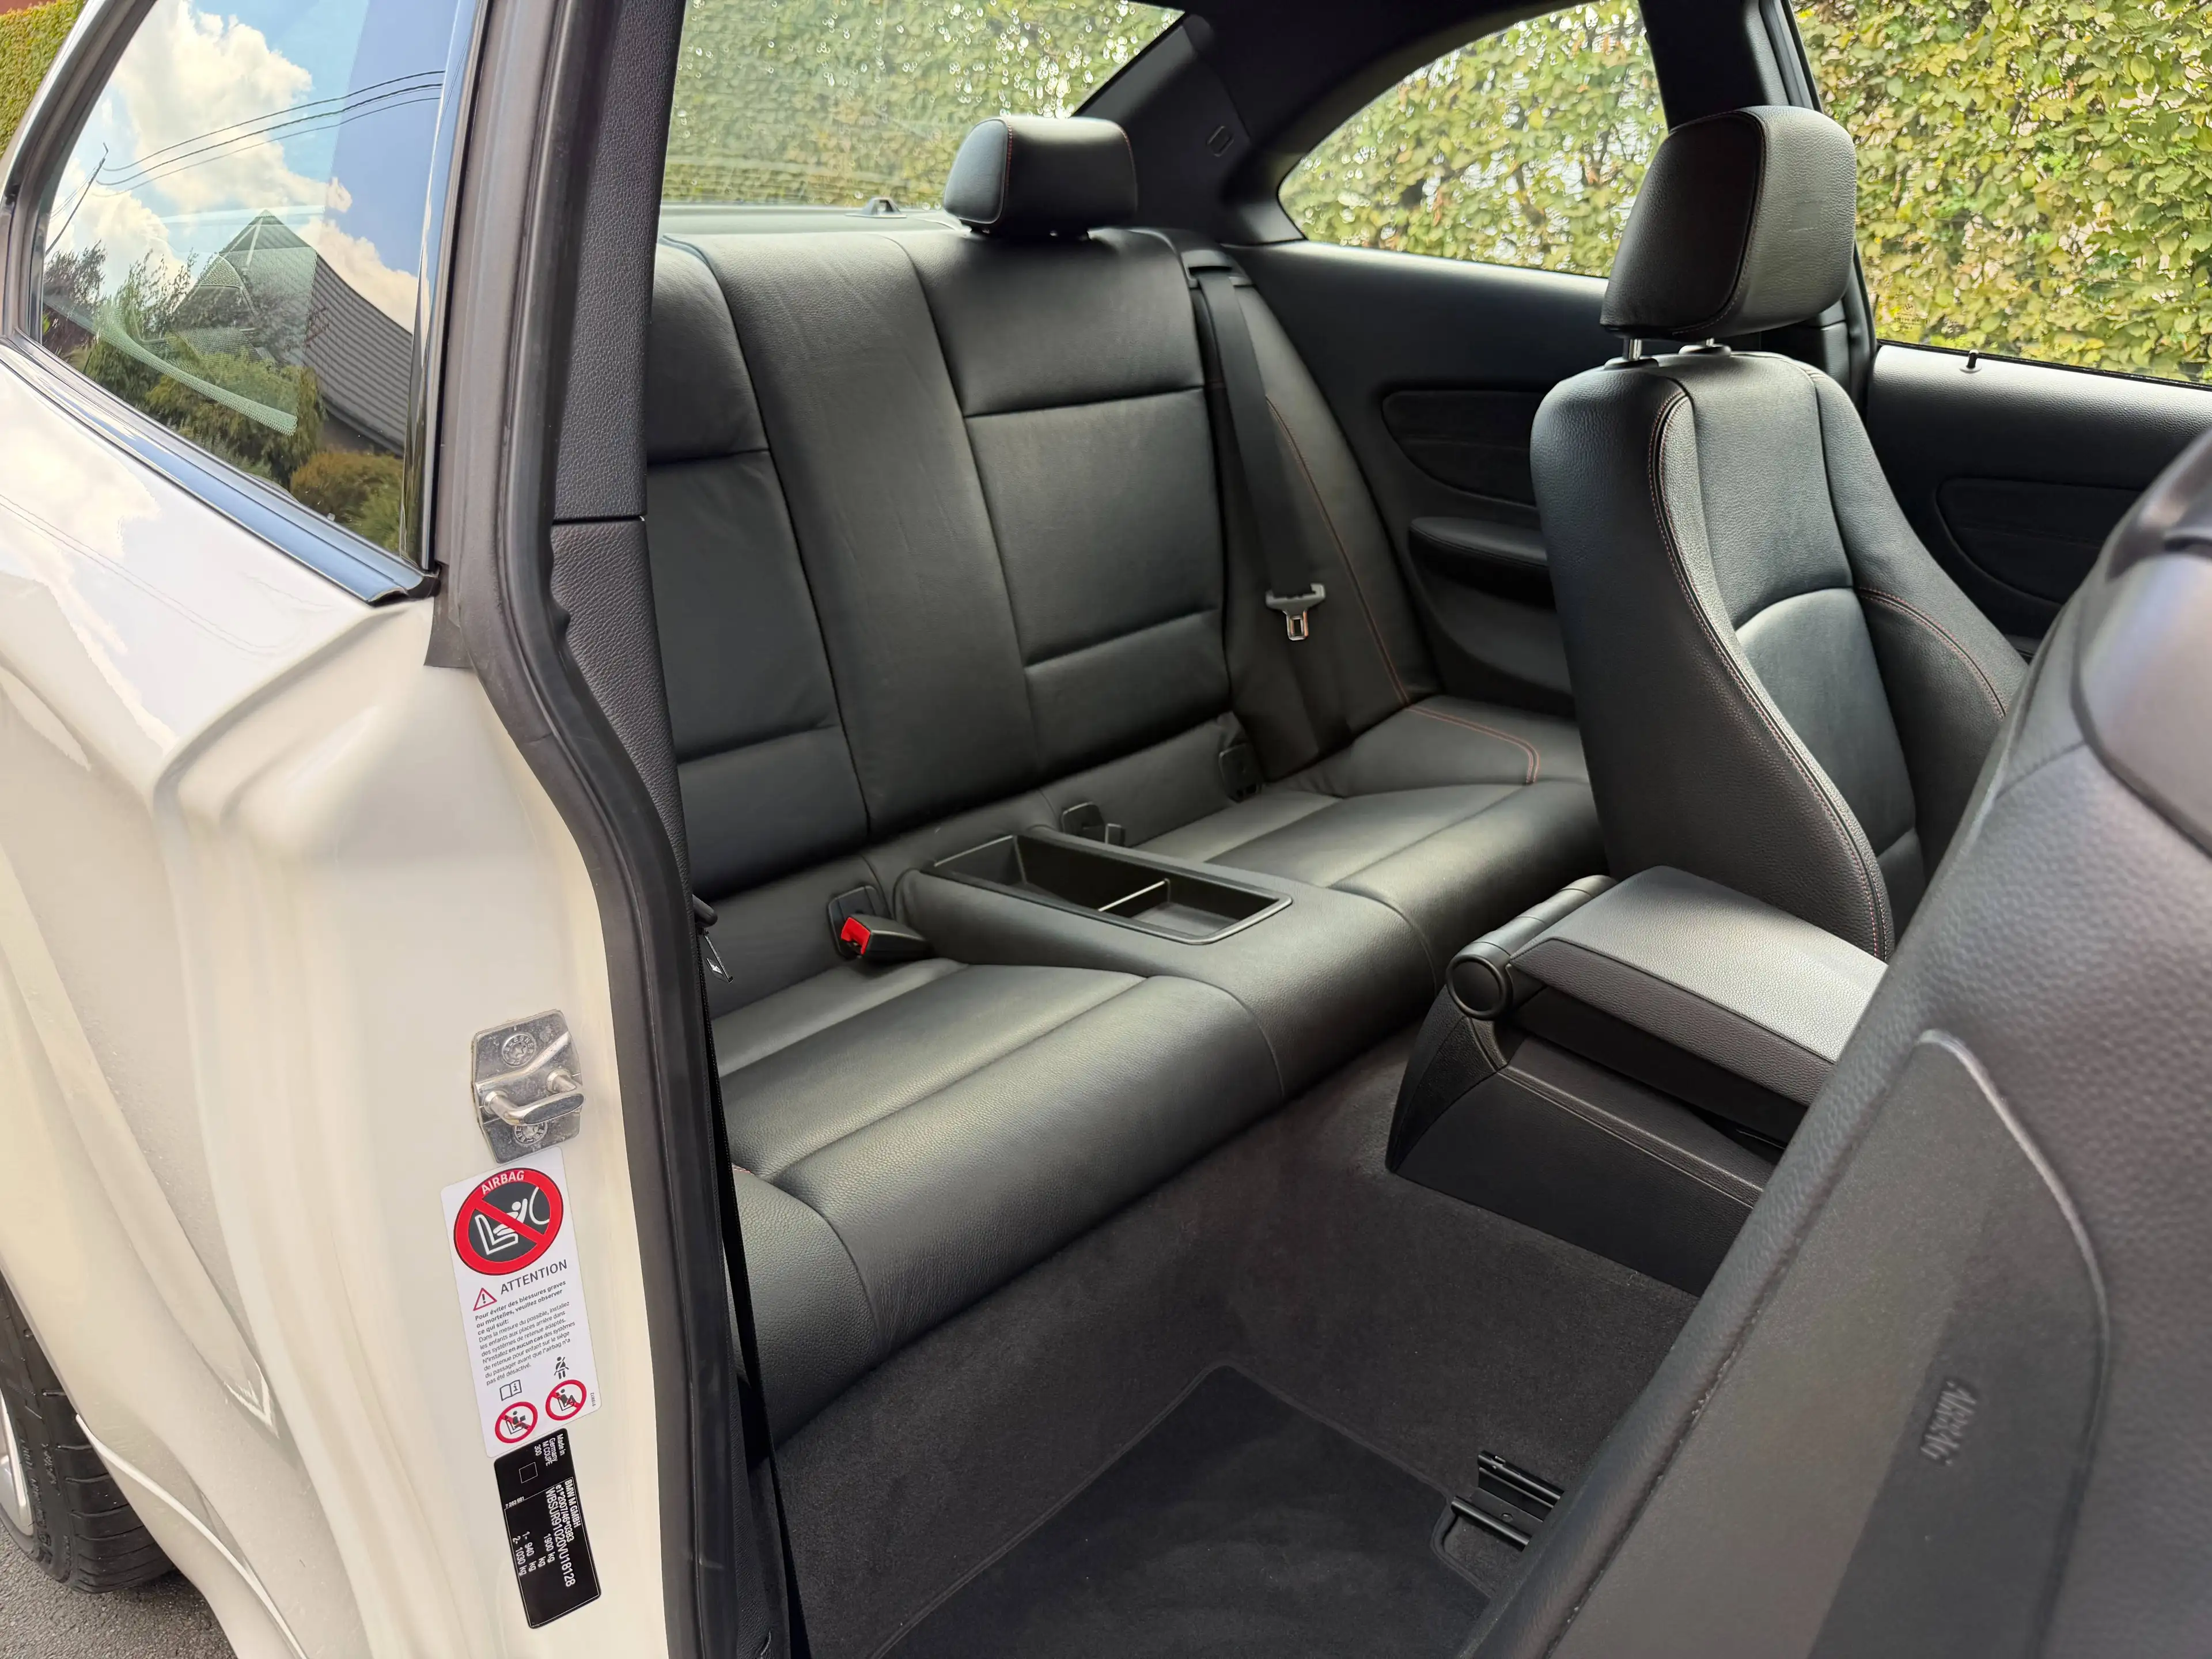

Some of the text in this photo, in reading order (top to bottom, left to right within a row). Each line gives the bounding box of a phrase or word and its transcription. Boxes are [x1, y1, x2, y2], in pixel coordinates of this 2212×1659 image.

[481, 1170, 525, 1195] AIRBAG
[501, 1259, 567, 1295] ATTENTION
[475, 1312, 489, 1321] Pour
[490, 1305, 507, 1315] éviter
[519, 1289, 547, 1303] blessures
[547, 1281, 566, 1293] graves
[485, 1310, 514, 1325] mortelles,
[515, 1300, 537, 1312] veuillez
[537, 1289, 563, 1303] observer
[479, 1334, 493, 1343] Dans
[499, 1323, 518, 1335] mesure
[527, 1310, 549, 1323] possible,
[550, 1301, 570, 1313] installez
[486, 1324, 495, 1332] qui
[496, 1319, 509, 1328] suit:
[488, 1335, 508, 1346] enfants
[509, 1330, 518, 1338] aux
[518, 1323, 535, 1335] places
[536, 1316, 552, 1327] arrière
[553, 1310, 566, 1319] dans
[491, 1339, 516, 1353] systèmes
[524, 1327, 544, 1339] retenue
[516, 1339, 533, 1350] aucun
[552, 1321, 575, 1334] systèmes
[491, 1356, 512, 1368] retenue
[512, 1350, 525, 1360] pour
[525, 1343, 541, 1354] enfant
[556, 1331, 570, 1340] siège
[493, 1361, 516, 1376] passager
[517, 1354, 532, 1365] avant
[532, 1350, 543, 1358] que
[542, 1342, 562, 1354] l'airbag
[486, 1377, 497, 1387] pas
[497, 1373, 505, 1381] été
[534, 1444, 543, 1456] 300
[549, 1437, 558, 1462] Germany
[556, 1433, 565, 1450] Made
[543, 1446, 553, 1467] COUPE
[565, 1479, 581, 1528] BMW M GMBH
[524, 1542, 535, 1557] 940
[544, 1533, 555, 1563] 1900 kg
[546, 1487, 575, 1587] WBSUR91020VU18128
[515, 1547, 526, 1565] 1030
[528, 1560, 537, 1572] kg
[538, 1556, 546, 1568] kg
[519, 1565, 527, 1577] kg
